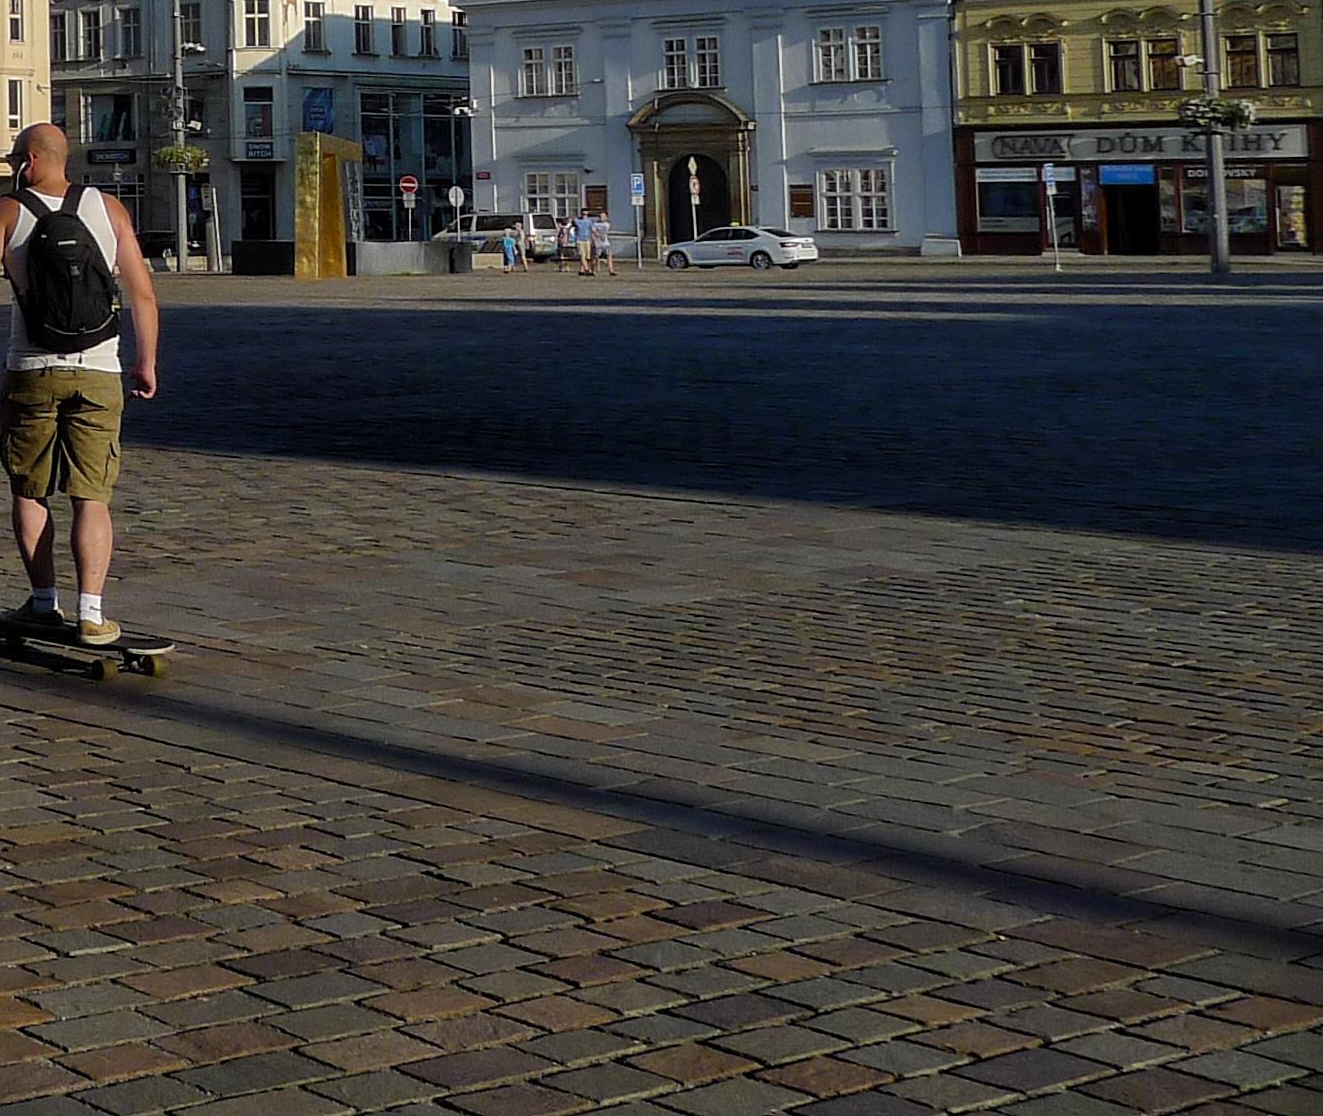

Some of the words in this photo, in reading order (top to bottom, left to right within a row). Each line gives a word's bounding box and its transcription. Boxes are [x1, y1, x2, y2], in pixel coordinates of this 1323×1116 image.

[999, 137, 1066, 155] NAVA
[1095, 131, 1165, 154] DŮM
[1181, 132, 1288, 152] KIHY
